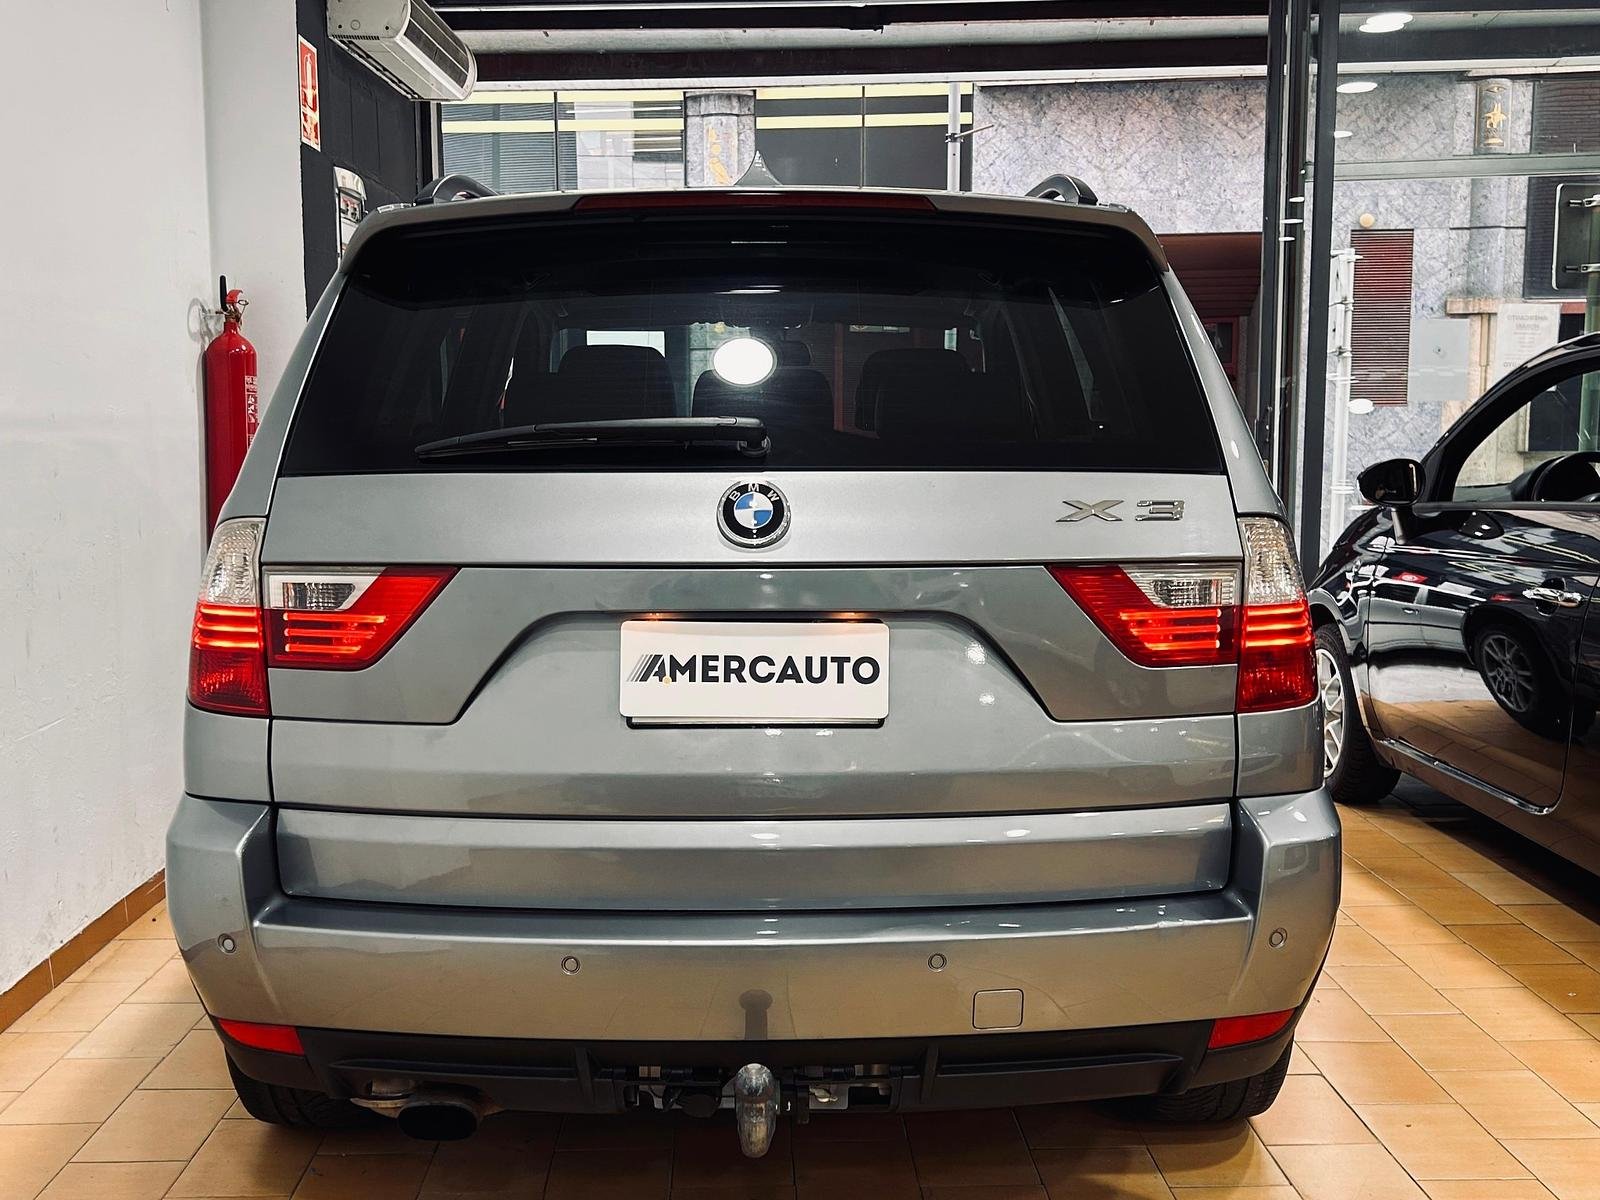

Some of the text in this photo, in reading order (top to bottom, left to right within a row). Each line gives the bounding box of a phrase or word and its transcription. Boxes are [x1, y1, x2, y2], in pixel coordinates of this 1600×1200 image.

[728, 483, 780, 502] BMW
[1055, 499, 1185, 522] X3
[633, 653, 881, 685] AMERCAUTO
